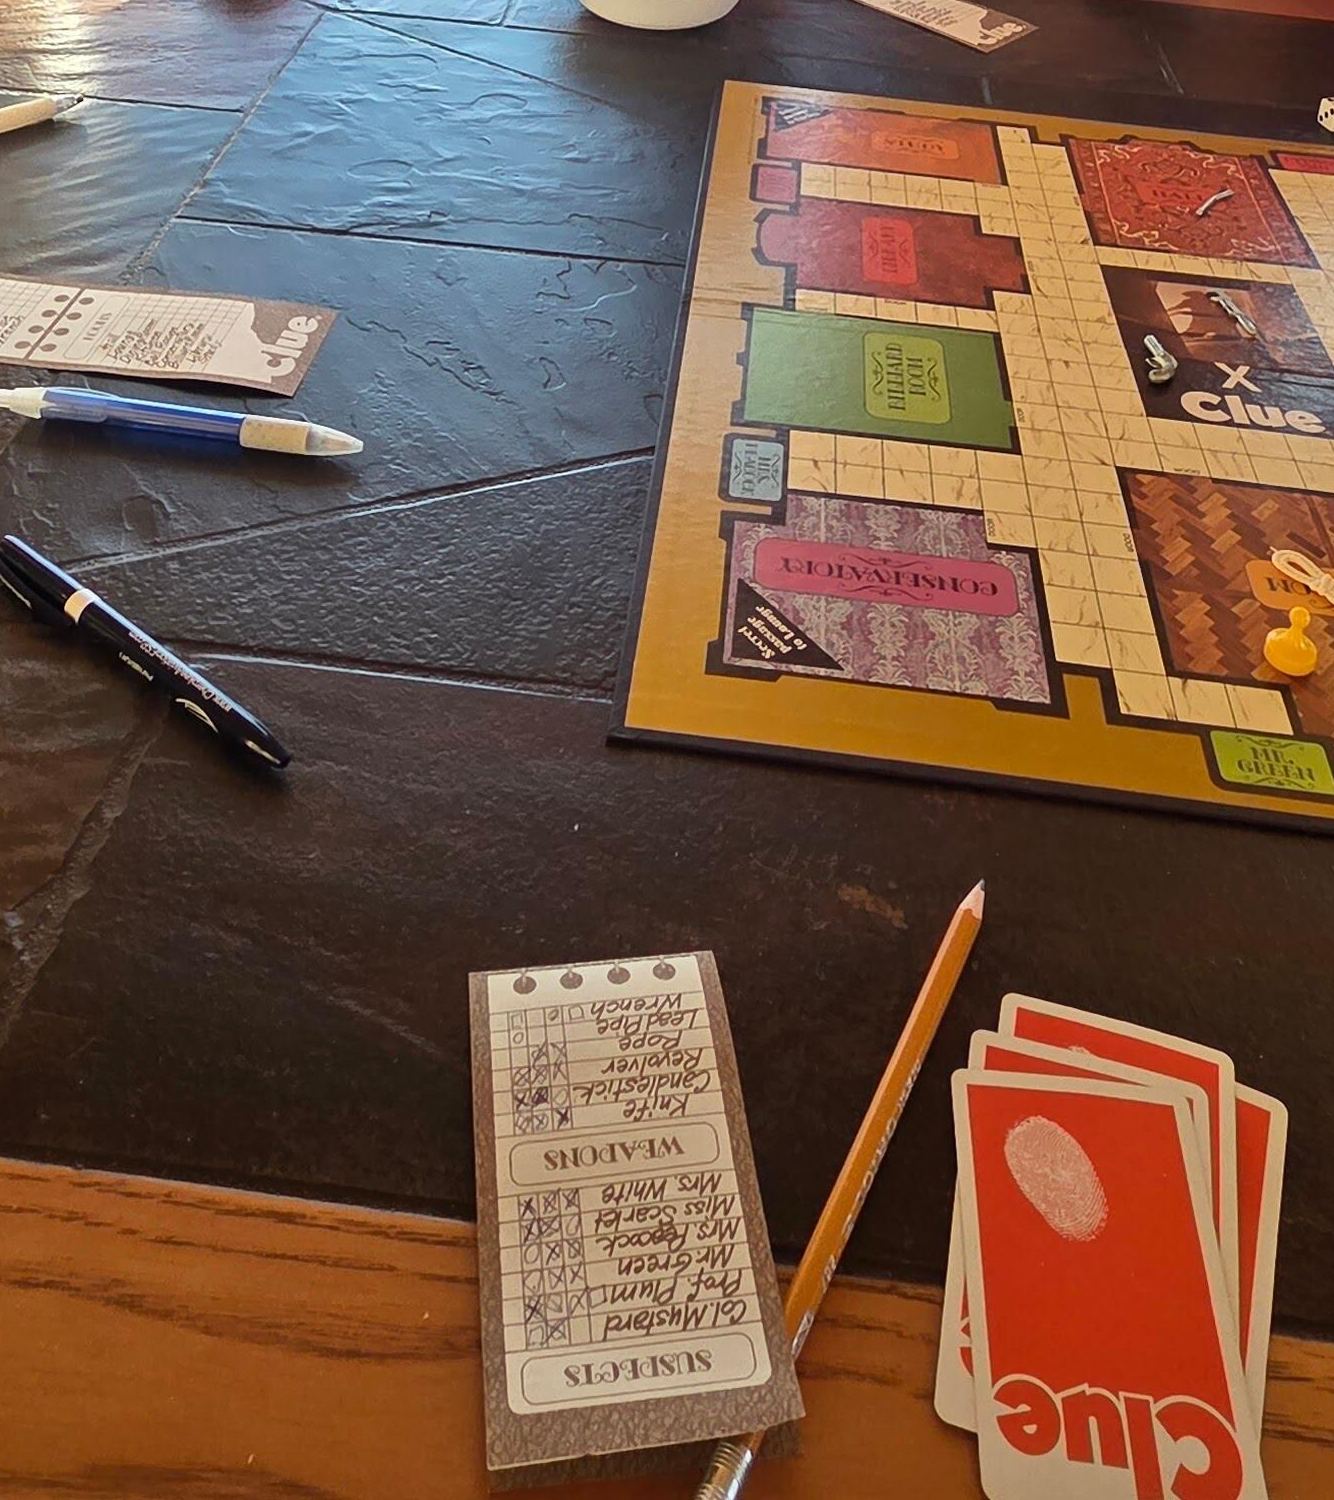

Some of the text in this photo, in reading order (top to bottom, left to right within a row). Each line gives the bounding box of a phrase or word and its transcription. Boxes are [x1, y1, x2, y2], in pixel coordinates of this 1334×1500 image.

[260, 315, 319, 378] Clue
[885, 342, 906, 411] BILLIARD
[1180, 391, 1327, 434] Clue
[781, 556, 998, 597] CONSERVATORY
[755, 606, 795, 640] Lounge
[1237, 759, 1316, 782] GREEN
[1250, 747, 1294, 765] MR.
[590, 993, 682, 1021] Wrench
[619, 1030, 682, 1054] Rope
[601, 1047, 704, 1076] Revolver
[572, 1068, 712, 1106] Candlestick
[623, 1093, 690, 1122] Knife
[544, 1135, 685, 1172] WEAPONS
[601, 1171, 722, 1204] Mrs. White
[594, 1195, 735, 1234] Miss Scarlet
[600, 1279, 679, 1306] Plum
[563, 1348, 713, 1388] SUSPECTS
[992, 1380, 1244, 1500] Clue
